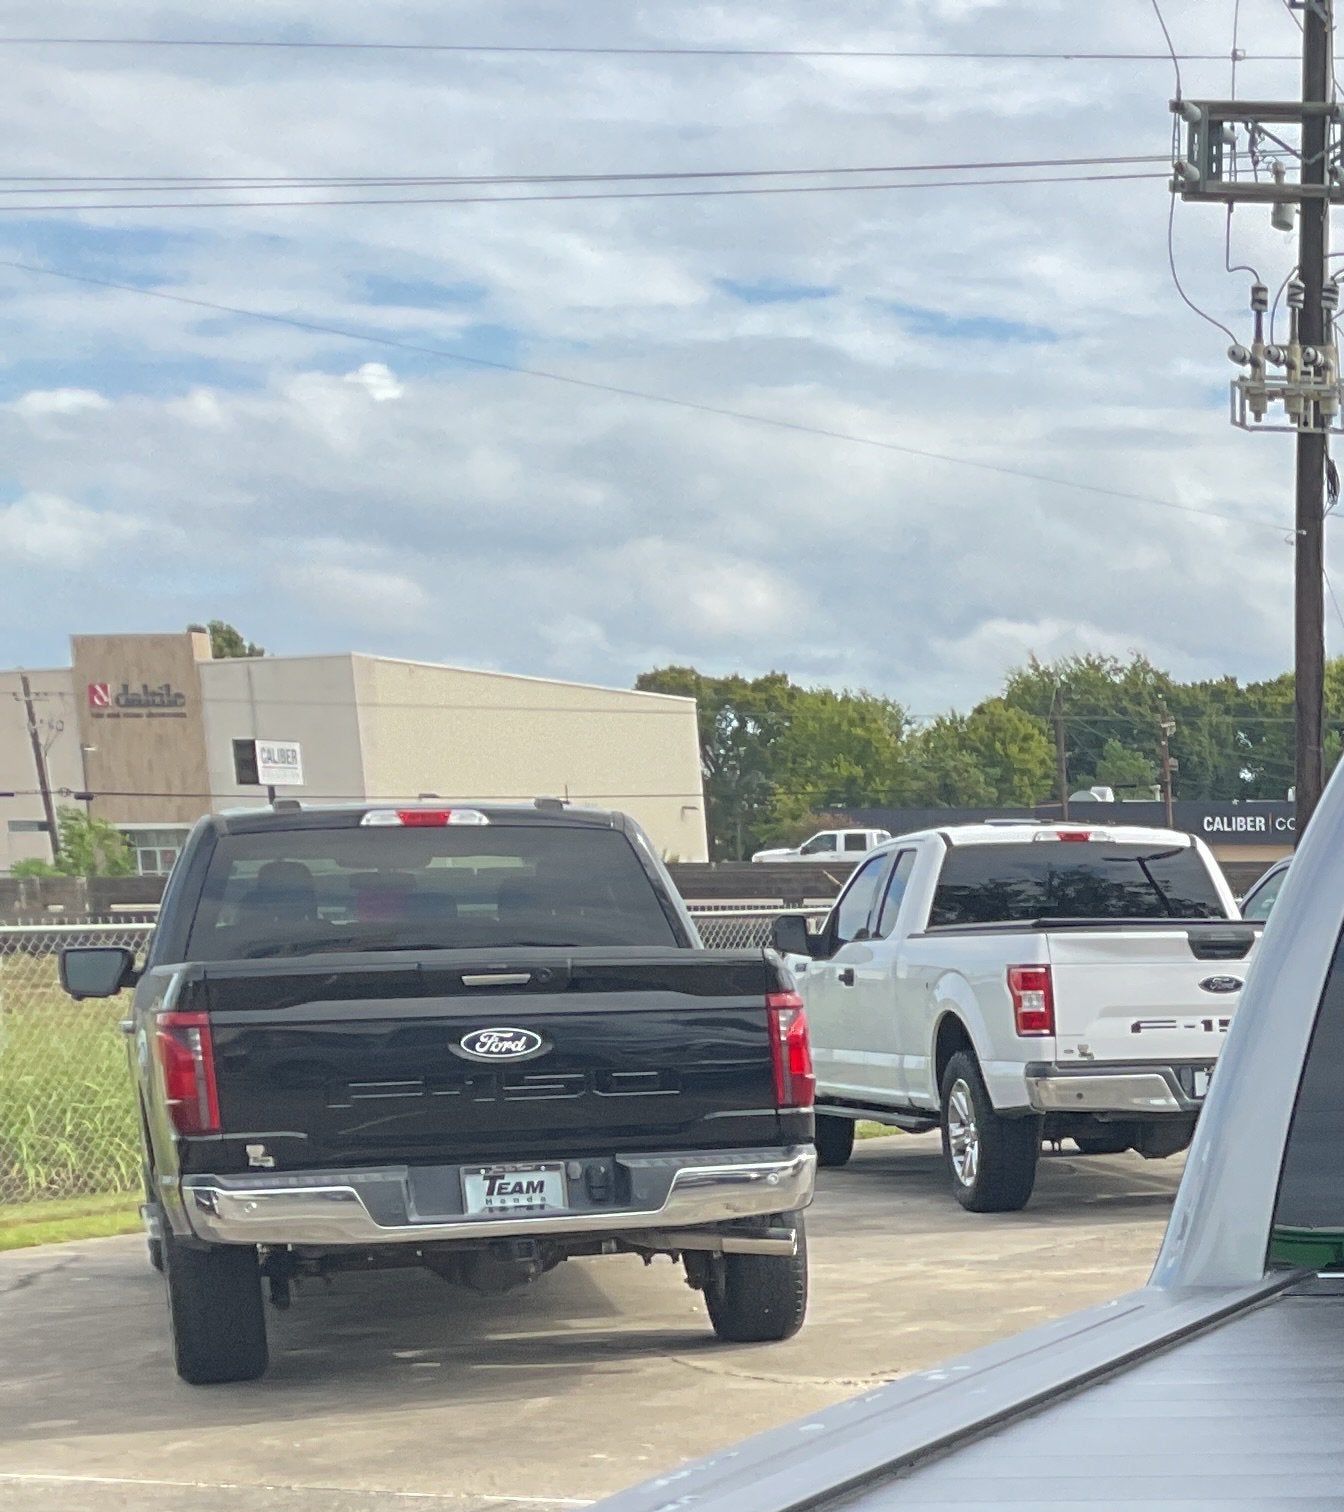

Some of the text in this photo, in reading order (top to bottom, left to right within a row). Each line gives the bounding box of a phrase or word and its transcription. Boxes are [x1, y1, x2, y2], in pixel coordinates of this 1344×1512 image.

[261, 746, 298, 765] CALIBER
[1203, 816, 1266, 832] CALIBER
[475, 1032, 527, 1053] Ford
[483, 1174, 545, 1196] TEAM
